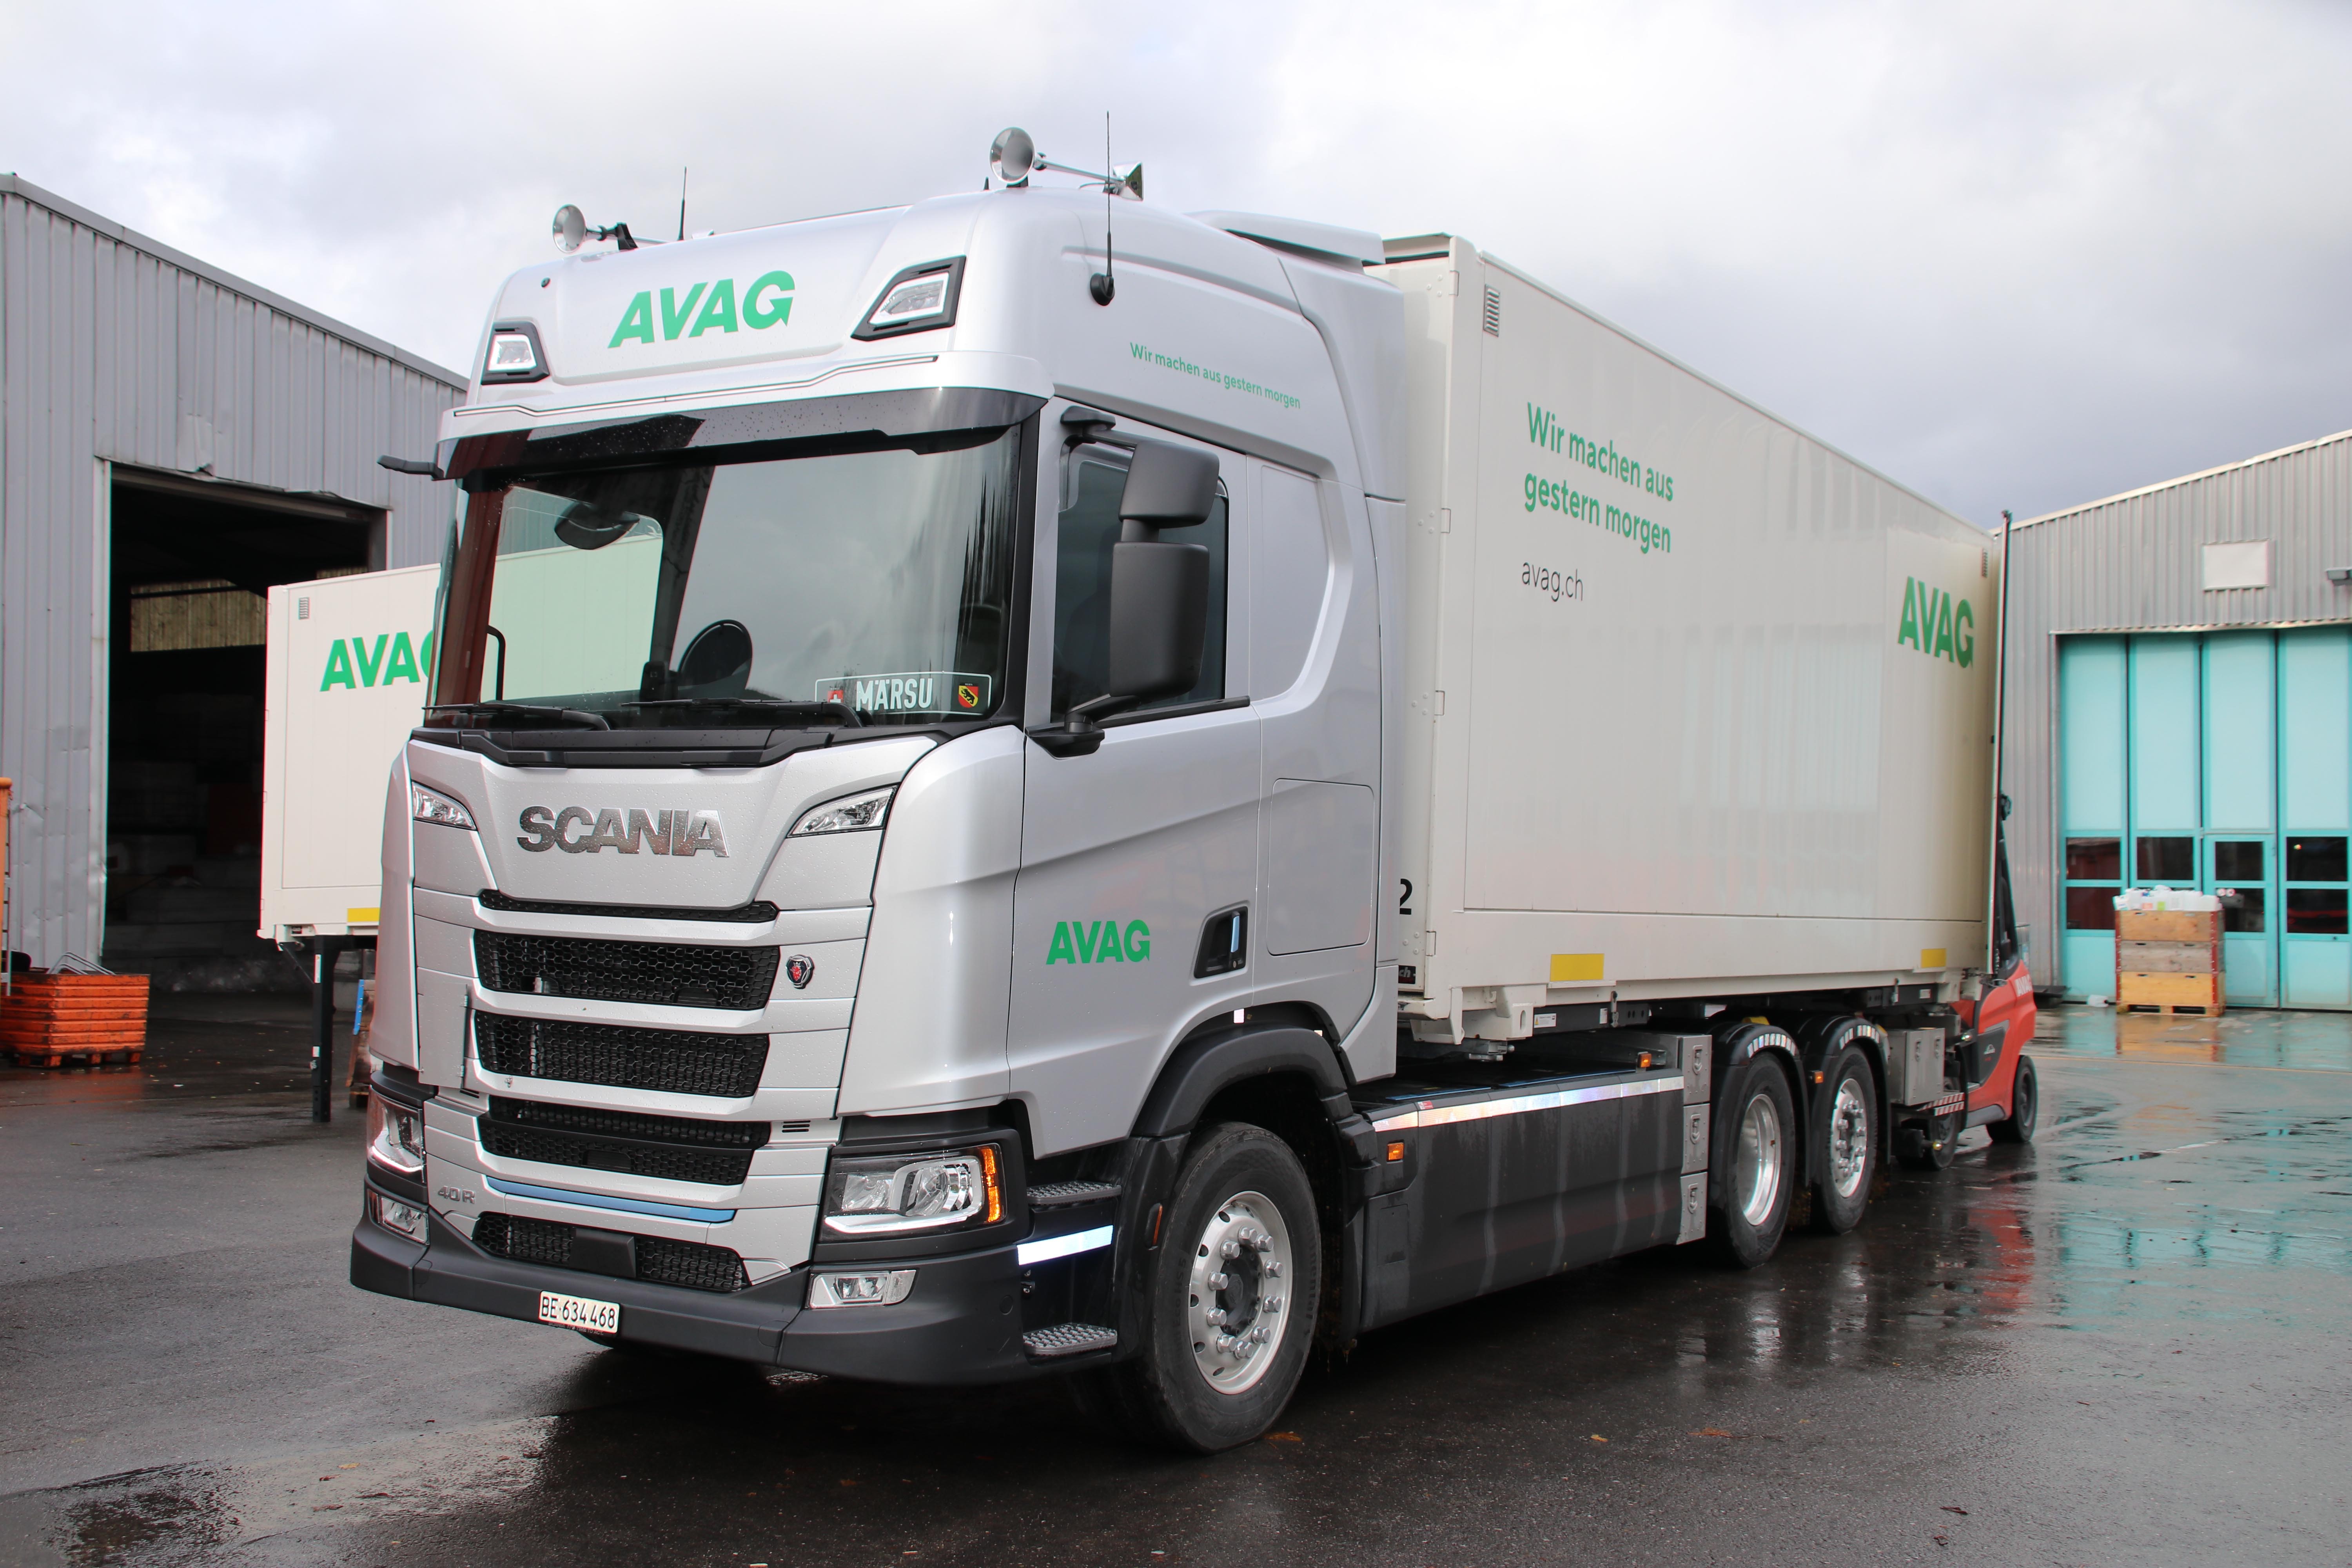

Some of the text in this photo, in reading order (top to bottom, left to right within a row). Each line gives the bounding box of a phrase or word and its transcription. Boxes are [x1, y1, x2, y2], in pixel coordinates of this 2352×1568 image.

[607, 270, 795, 348] AVAG
[1130, 342, 1301, 409] Wir machen aus gestern morgen
[1528, 402, 1674, 502] Wir machen aus
[1525, 473, 1671, 554] gestern morgen
[1522, 562, 1583, 602] avag.ch
[1897, 575, 1974, 669] AVAG
[855, 678, 933, 712] MÄRSU
[517, 805, 730, 858] SCANIA
[1045, 919, 1151, 965] AVAG
